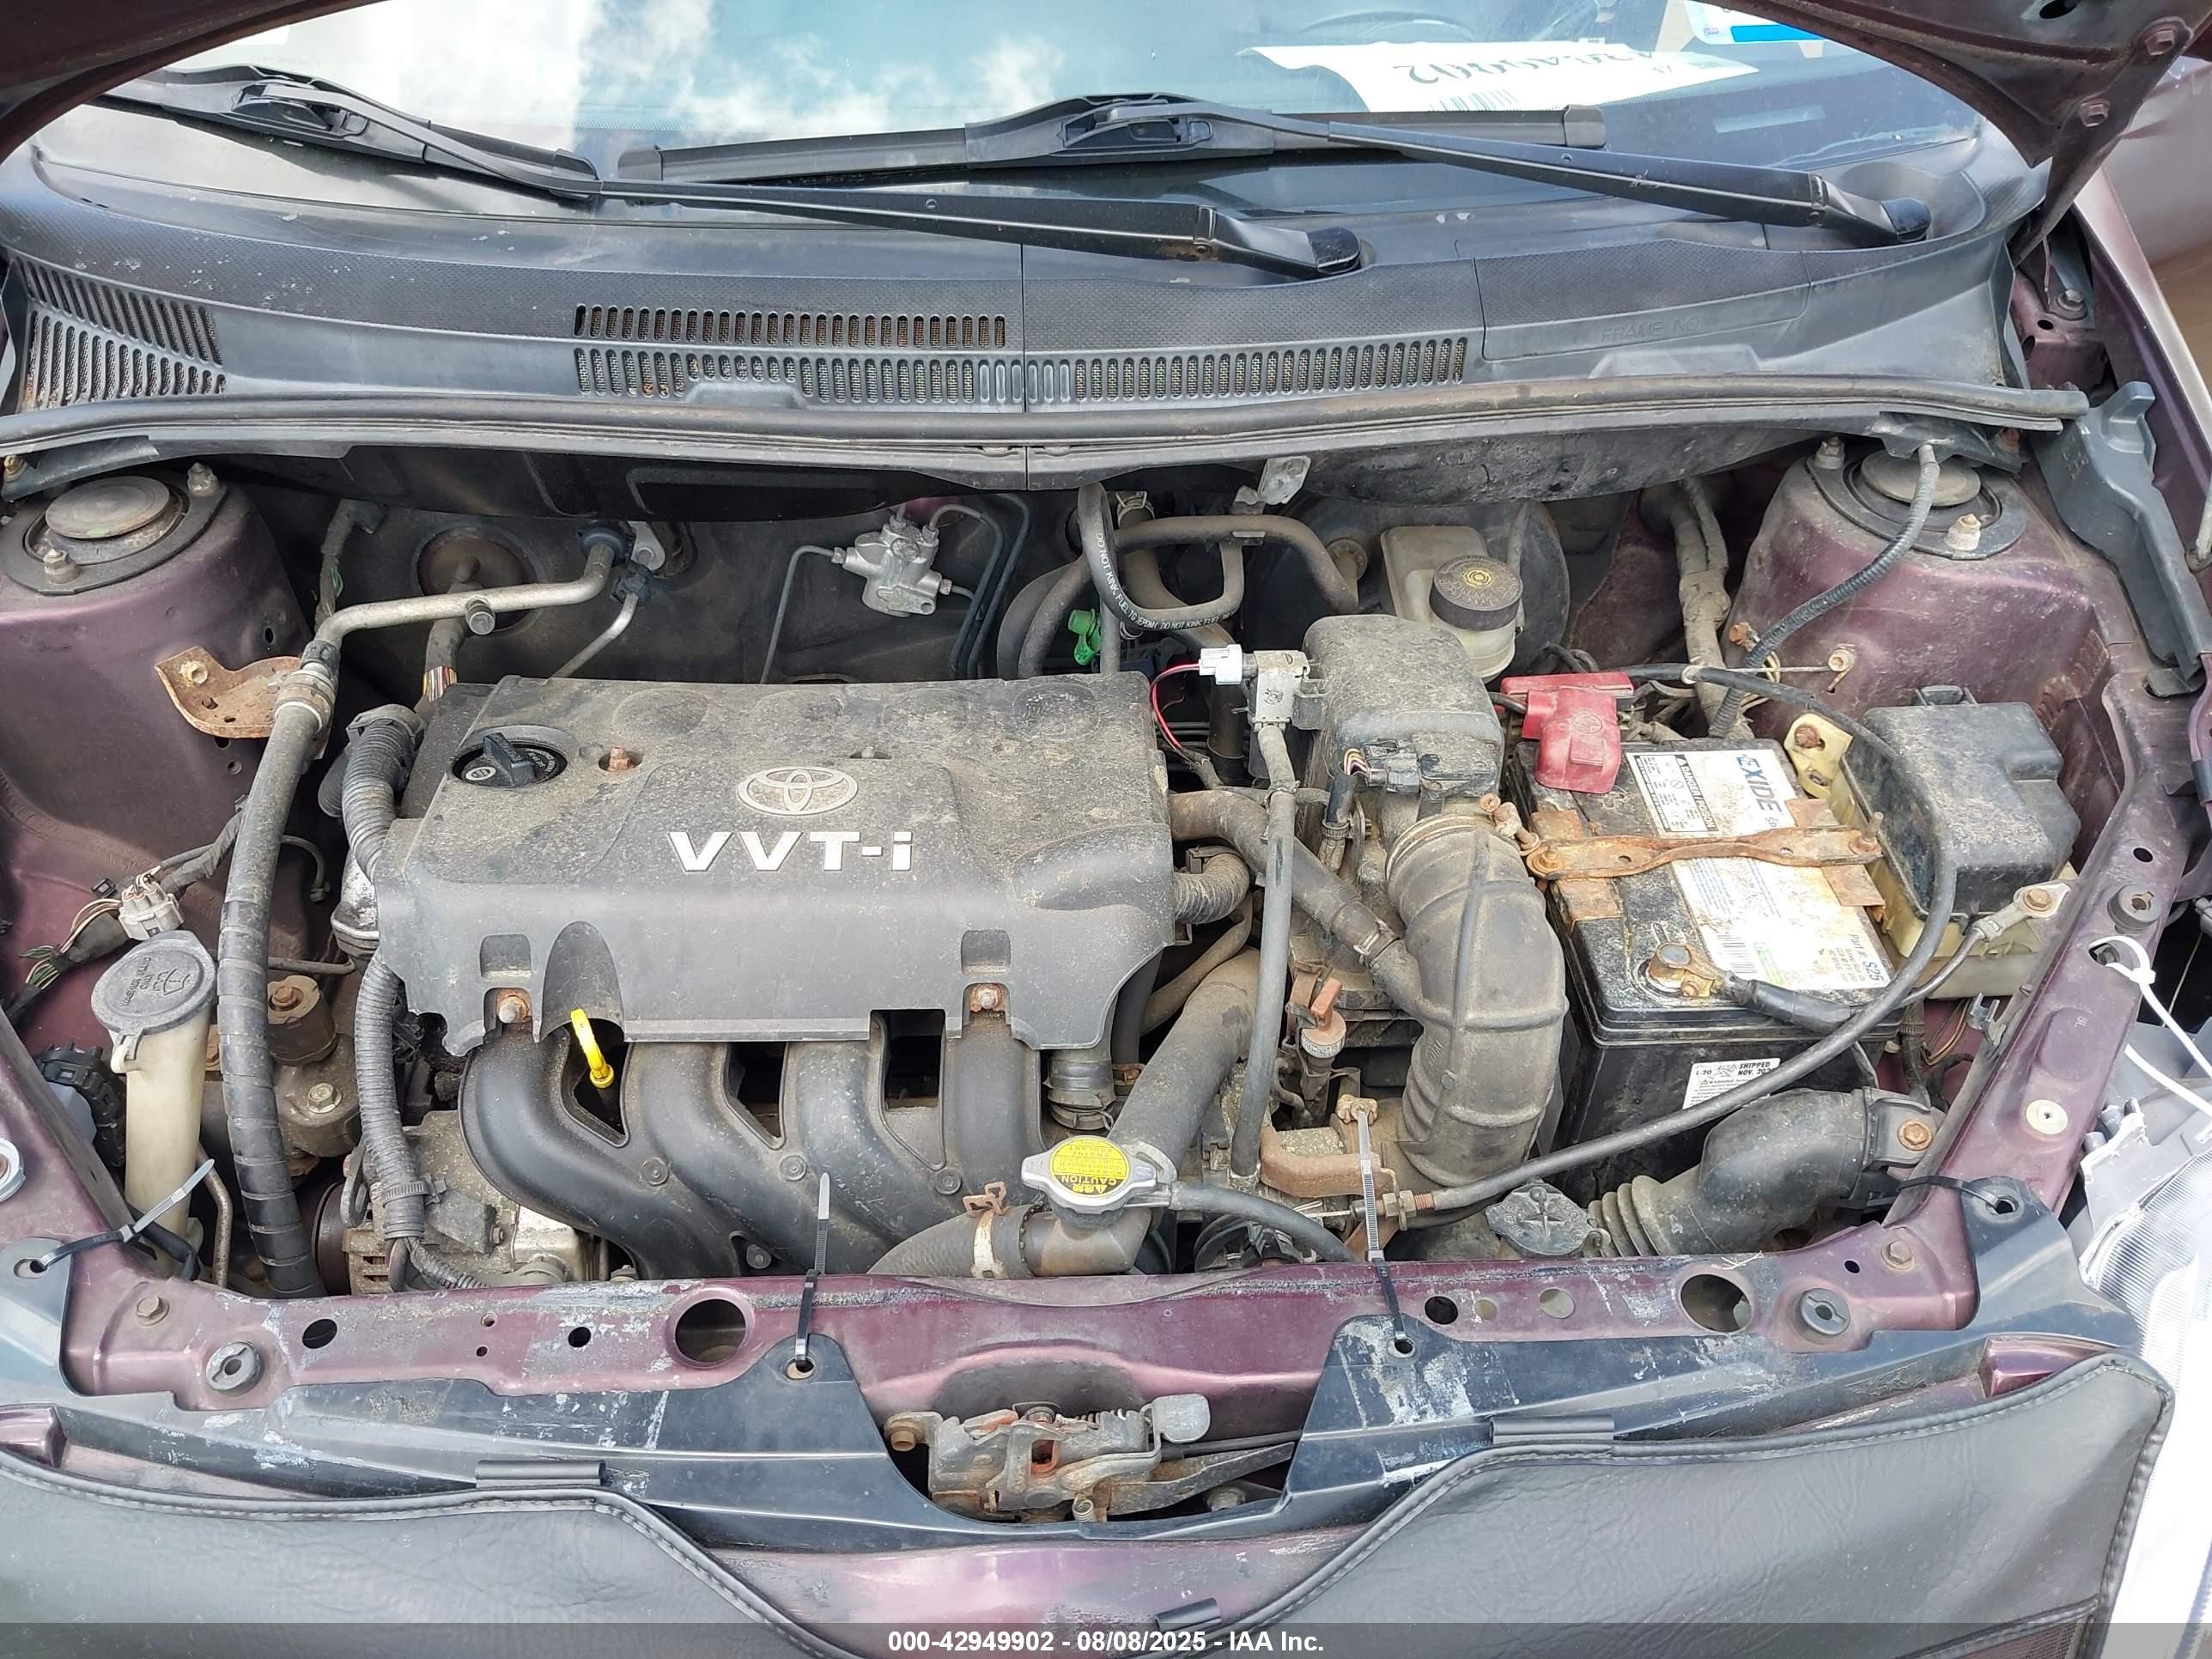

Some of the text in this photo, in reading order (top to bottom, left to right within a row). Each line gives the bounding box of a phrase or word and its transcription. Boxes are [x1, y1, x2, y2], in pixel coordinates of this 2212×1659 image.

[1601, 320, 1663, 343] FRAME
[1096, 532, 1104, 547] DO
[1099, 550, 1111, 569] NOT
[1105, 571, 1120, 596] KINK
[1115, 593, 1128, 615] FUEL
[1170, 621, 1186, 629] NOT
[1736, 754, 1783, 812] EXIDE
[668, 831, 914, 872] VVT-i
[1863, 961, 1885, 981] S25
[1061, 1175, 1117, 1185] CAUTION
